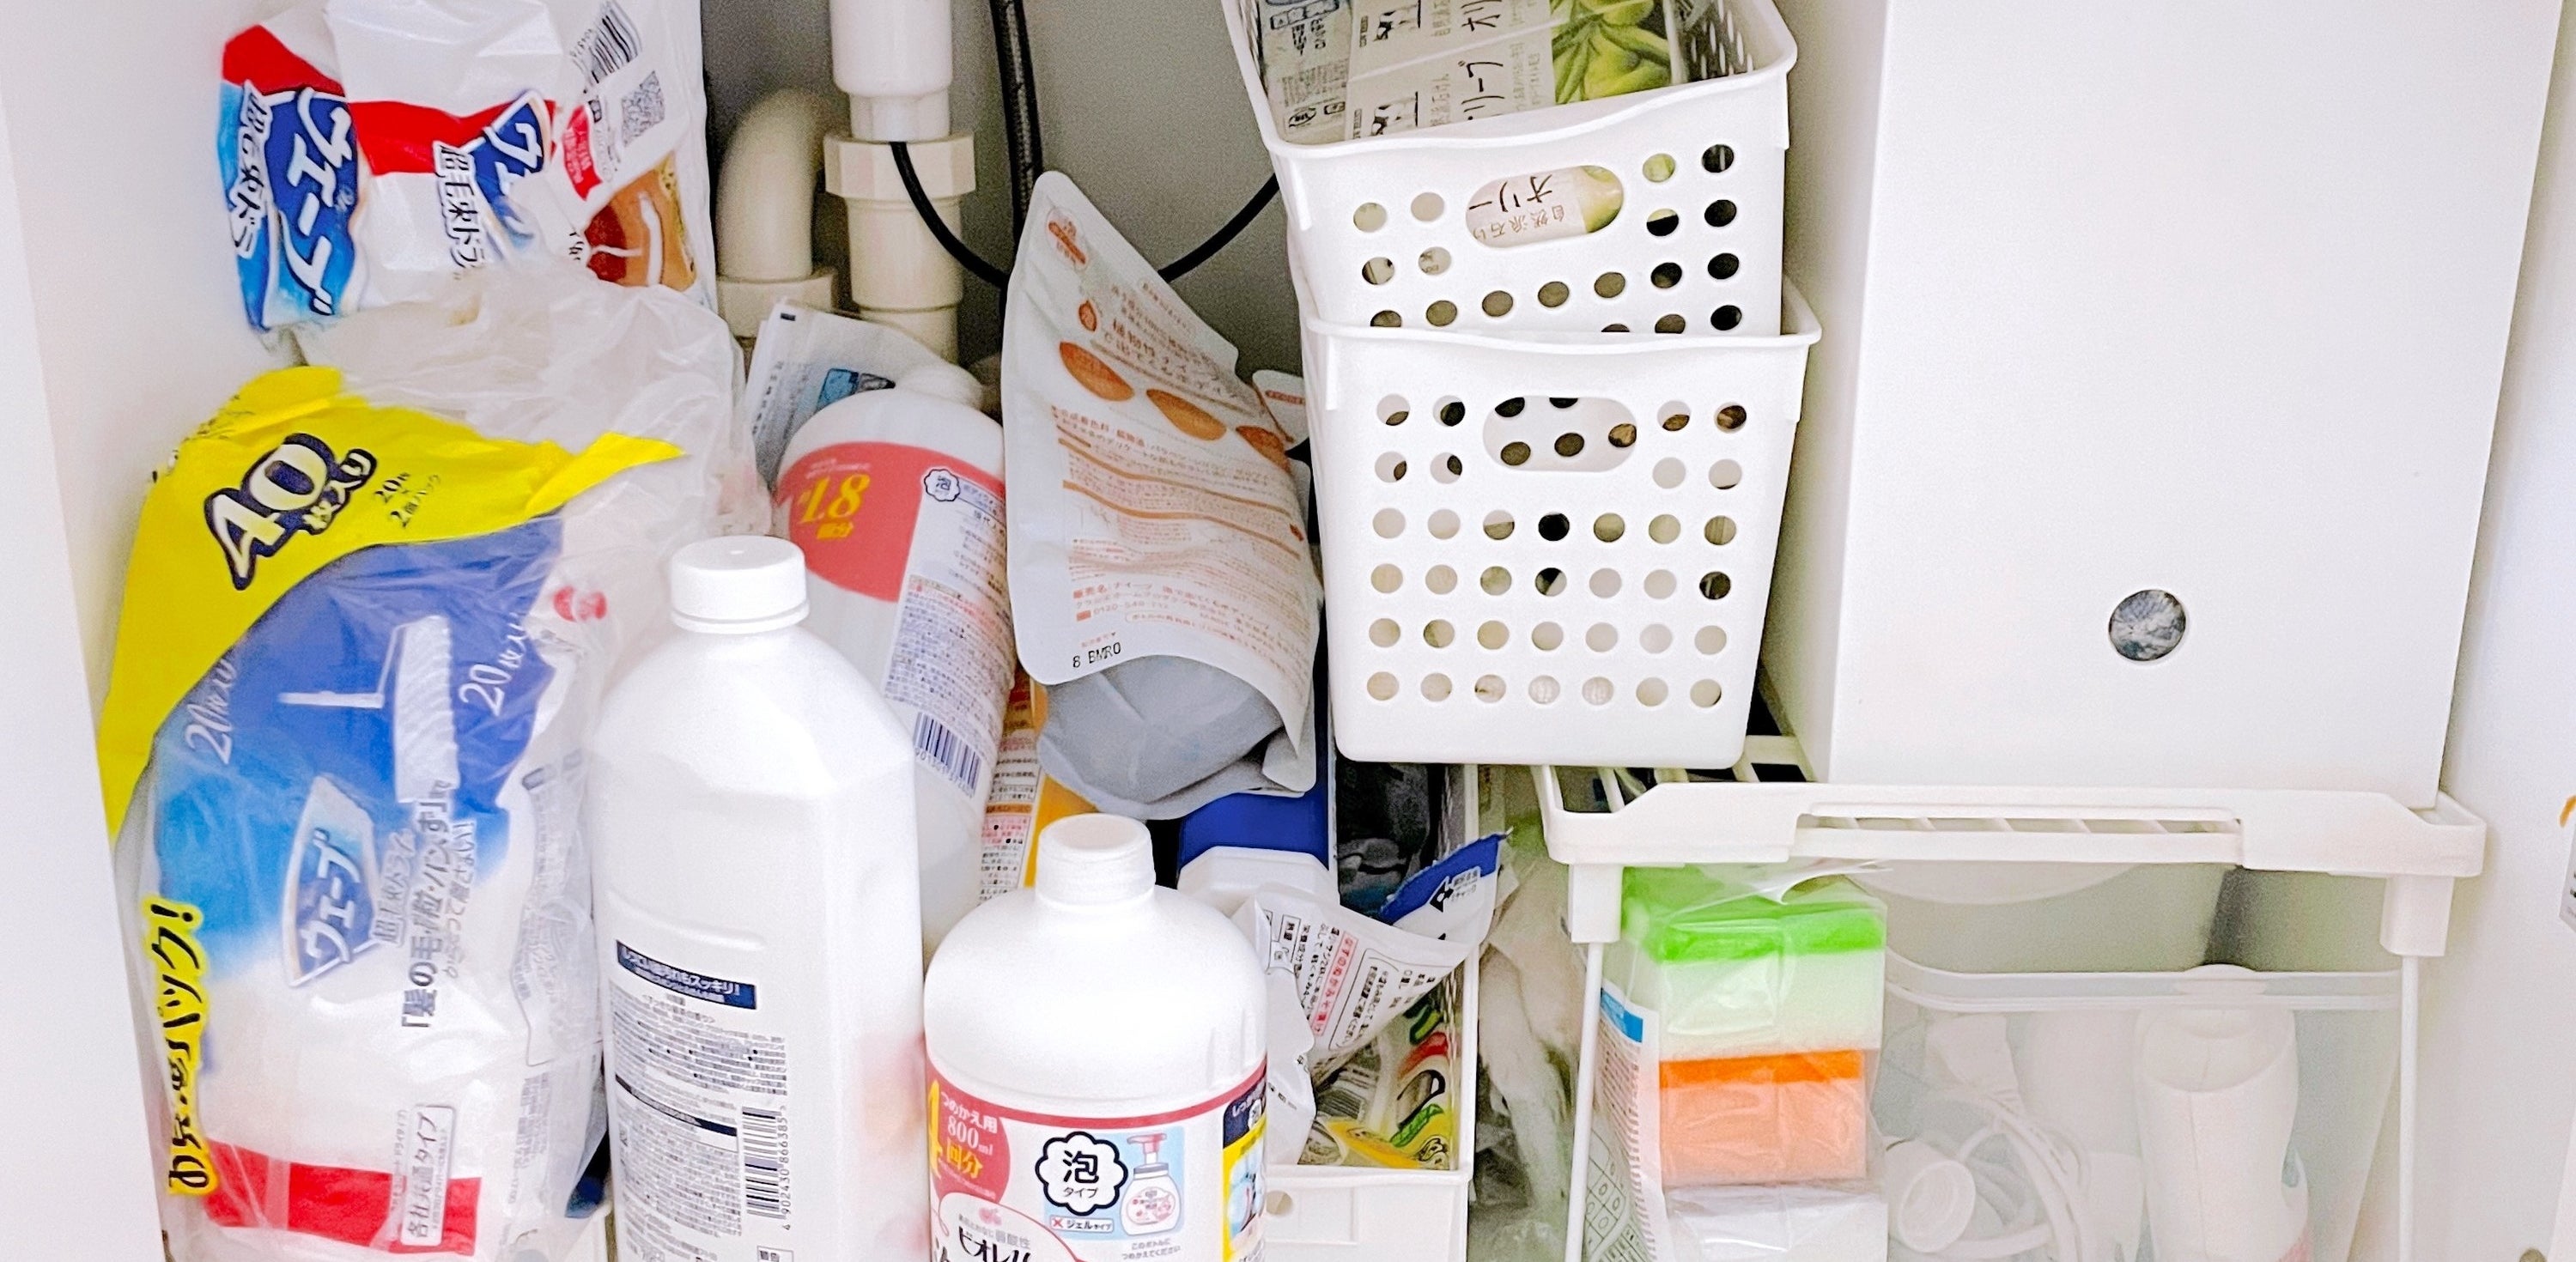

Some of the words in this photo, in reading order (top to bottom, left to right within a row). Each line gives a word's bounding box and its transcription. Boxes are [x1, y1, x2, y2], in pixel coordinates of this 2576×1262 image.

[1457, 60, 1506, 121] リーブ
[1468, 174, 1553, 212] オリー
[1062, 1150, 1100, 1184] 泡
[1063, 1186, 1099, 1199] タイプ
